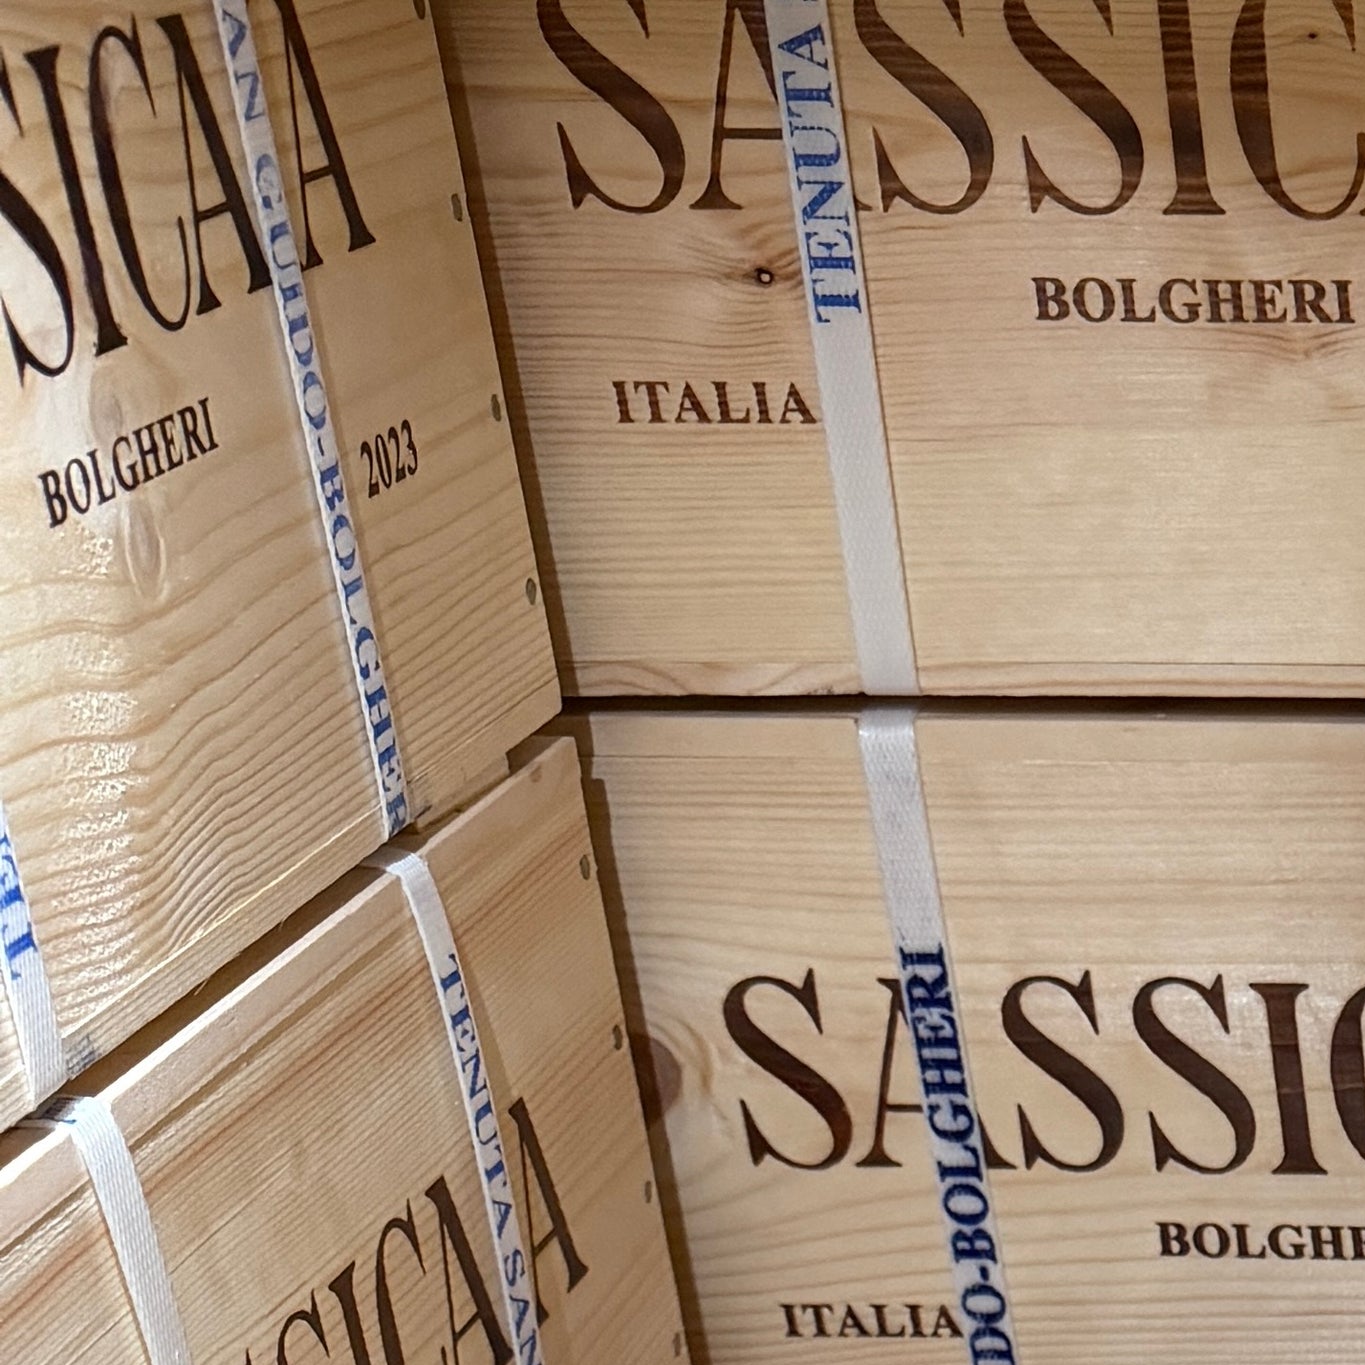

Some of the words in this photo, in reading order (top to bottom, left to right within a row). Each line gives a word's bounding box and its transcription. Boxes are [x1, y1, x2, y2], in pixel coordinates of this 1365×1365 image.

[778, 20, 863, 326] TENUTA
[1031, 277, 1357, 325] BOLGHERI
[612, 380, 818, 425] ITALIA
[38, 397, 220, 529] BOLGHERI
[359, 419, 420, 500] 2023
[440, 952, 517, 1242] TENUTA
[780, 1302, 963, 1339] ITALIA
